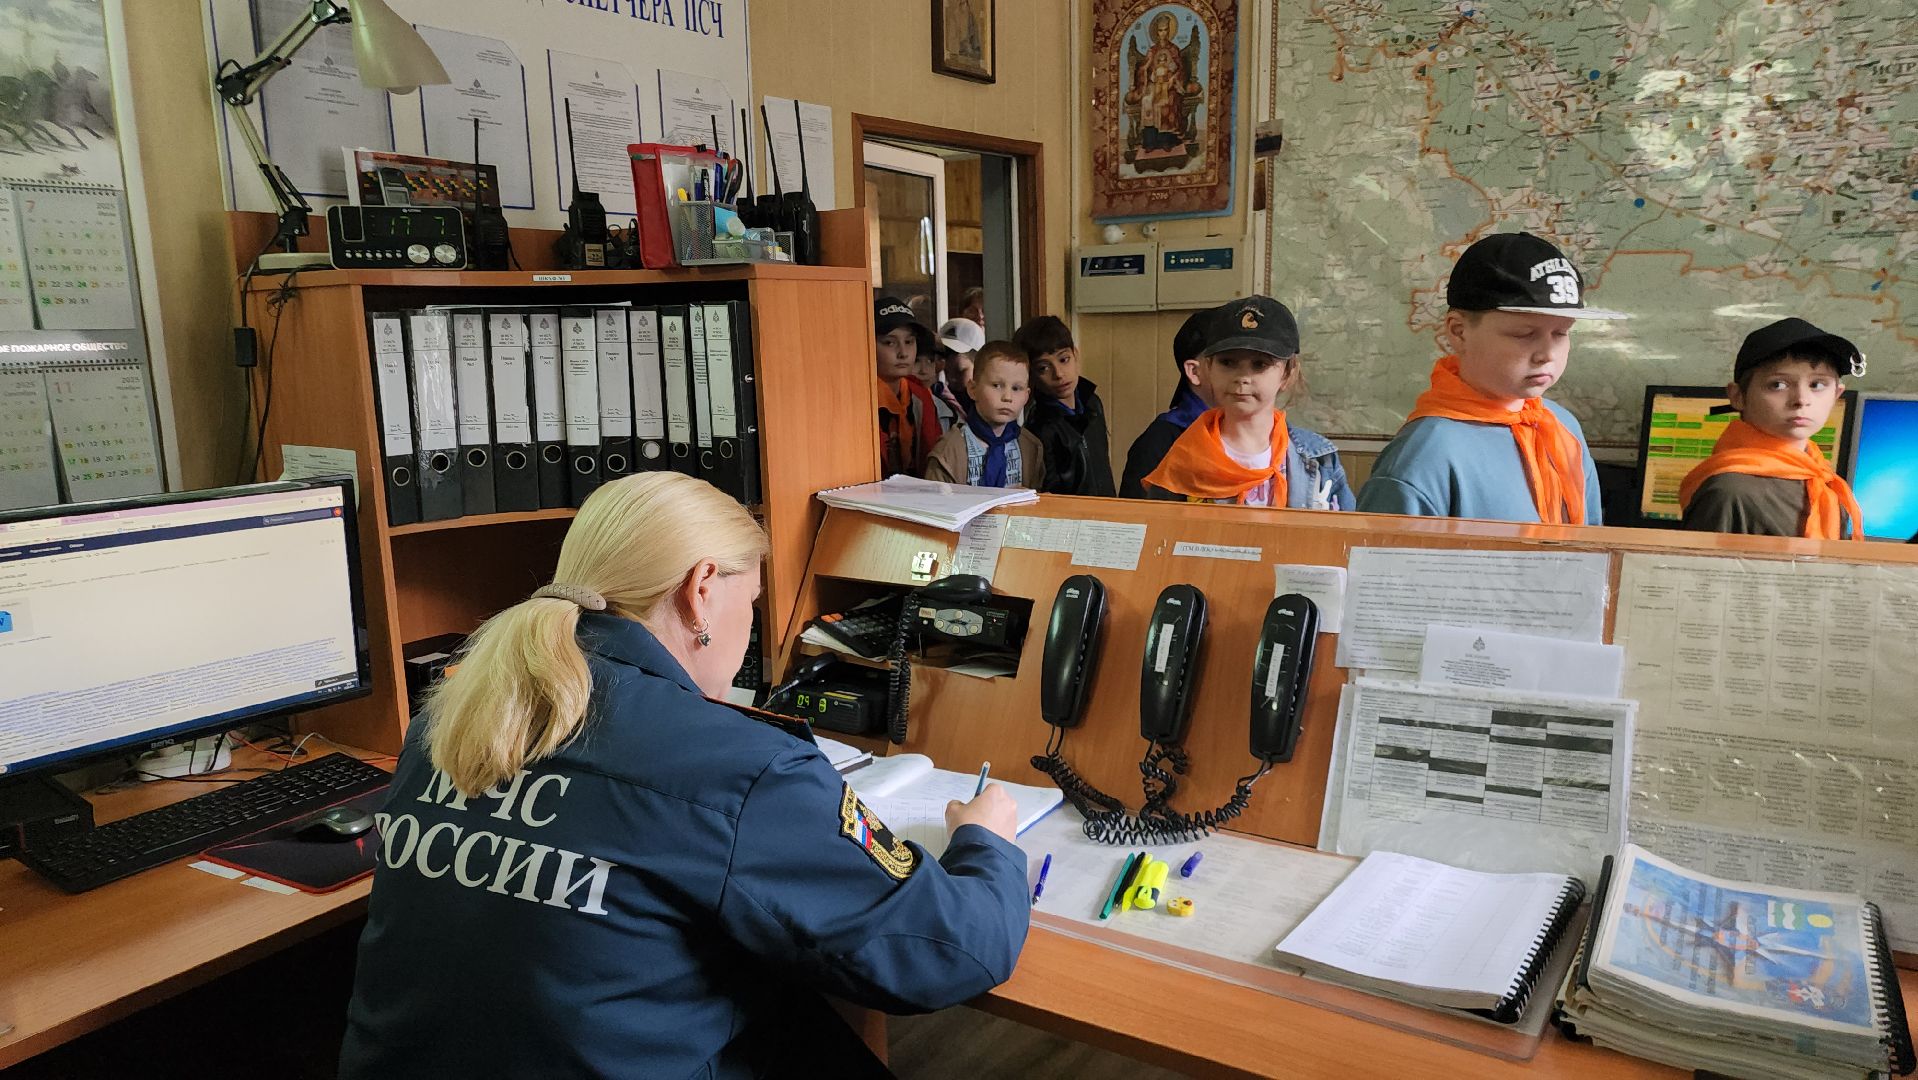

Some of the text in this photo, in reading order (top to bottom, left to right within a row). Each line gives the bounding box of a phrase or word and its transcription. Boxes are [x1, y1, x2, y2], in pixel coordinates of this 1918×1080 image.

[685, 0, 724, 38] ПСЧ
[1547, 275, 1579, 304] 39
[10, 343, 71, 353] ПОЖАРНОЕ
[72, 342, 128, 352] ОБЩЕСТВО
[416, 769, 572, 828] МЧС
